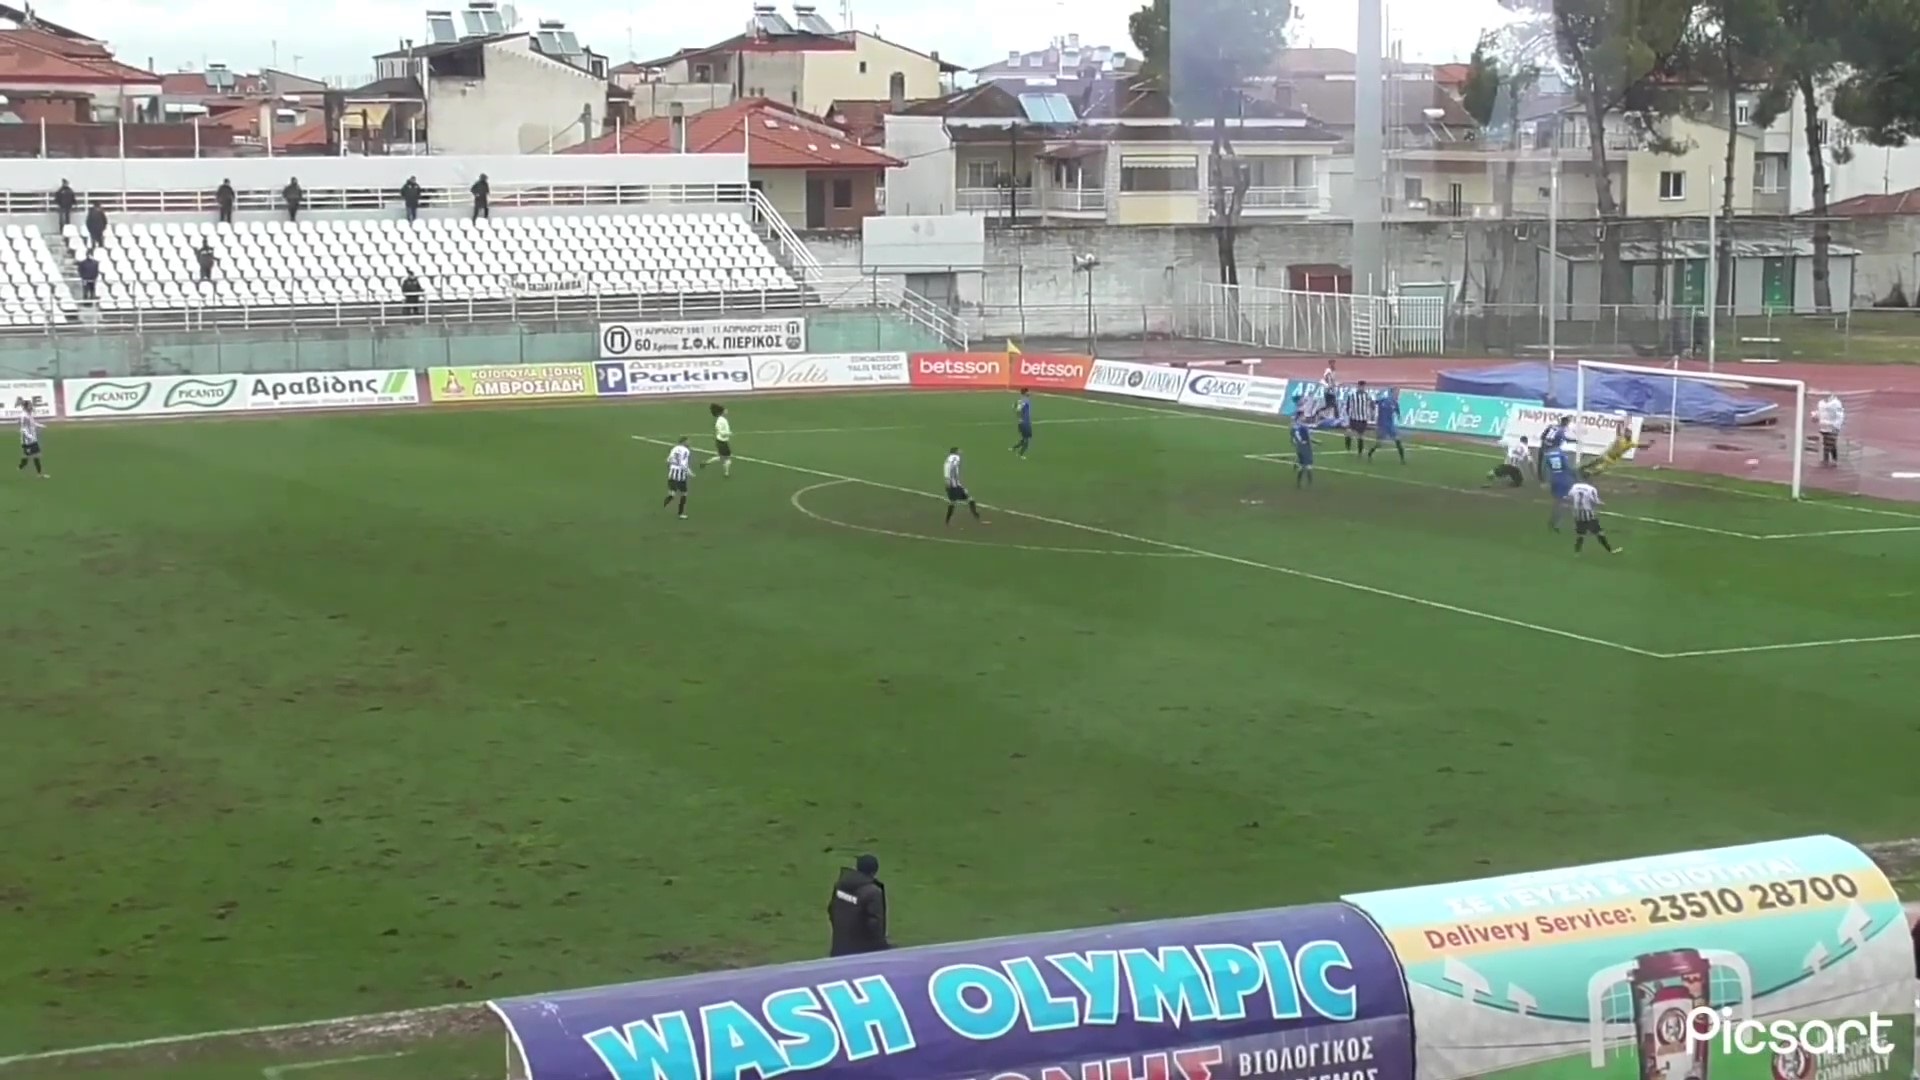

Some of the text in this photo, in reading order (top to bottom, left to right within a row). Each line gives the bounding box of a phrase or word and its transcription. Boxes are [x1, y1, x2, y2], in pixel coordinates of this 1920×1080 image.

[634, 339, 651, 351] 60
[723, 335, 782, 349] ΠΙΕΡΙΚΟΣ
[630, 369, 749, 383] Parking
[756, 357, 831, 386] Valis
[919, 358, 1000, 374] betsson
[1020, 358, 1084, 377] betsson
[251, 375, 379, 400] Αραβίδης
[474, 379, 585, 396] ΑΜΒΡΟΣΙΑΔΗ
[1424, 873, 1859, 950] Delivery Service: 23510 28700
[583, 939, 1358, 1080] WASH OLYMPIC
[1239, 1035, 1374, 1077] ΒΙΟΛΟΓΙΚΟΣ
